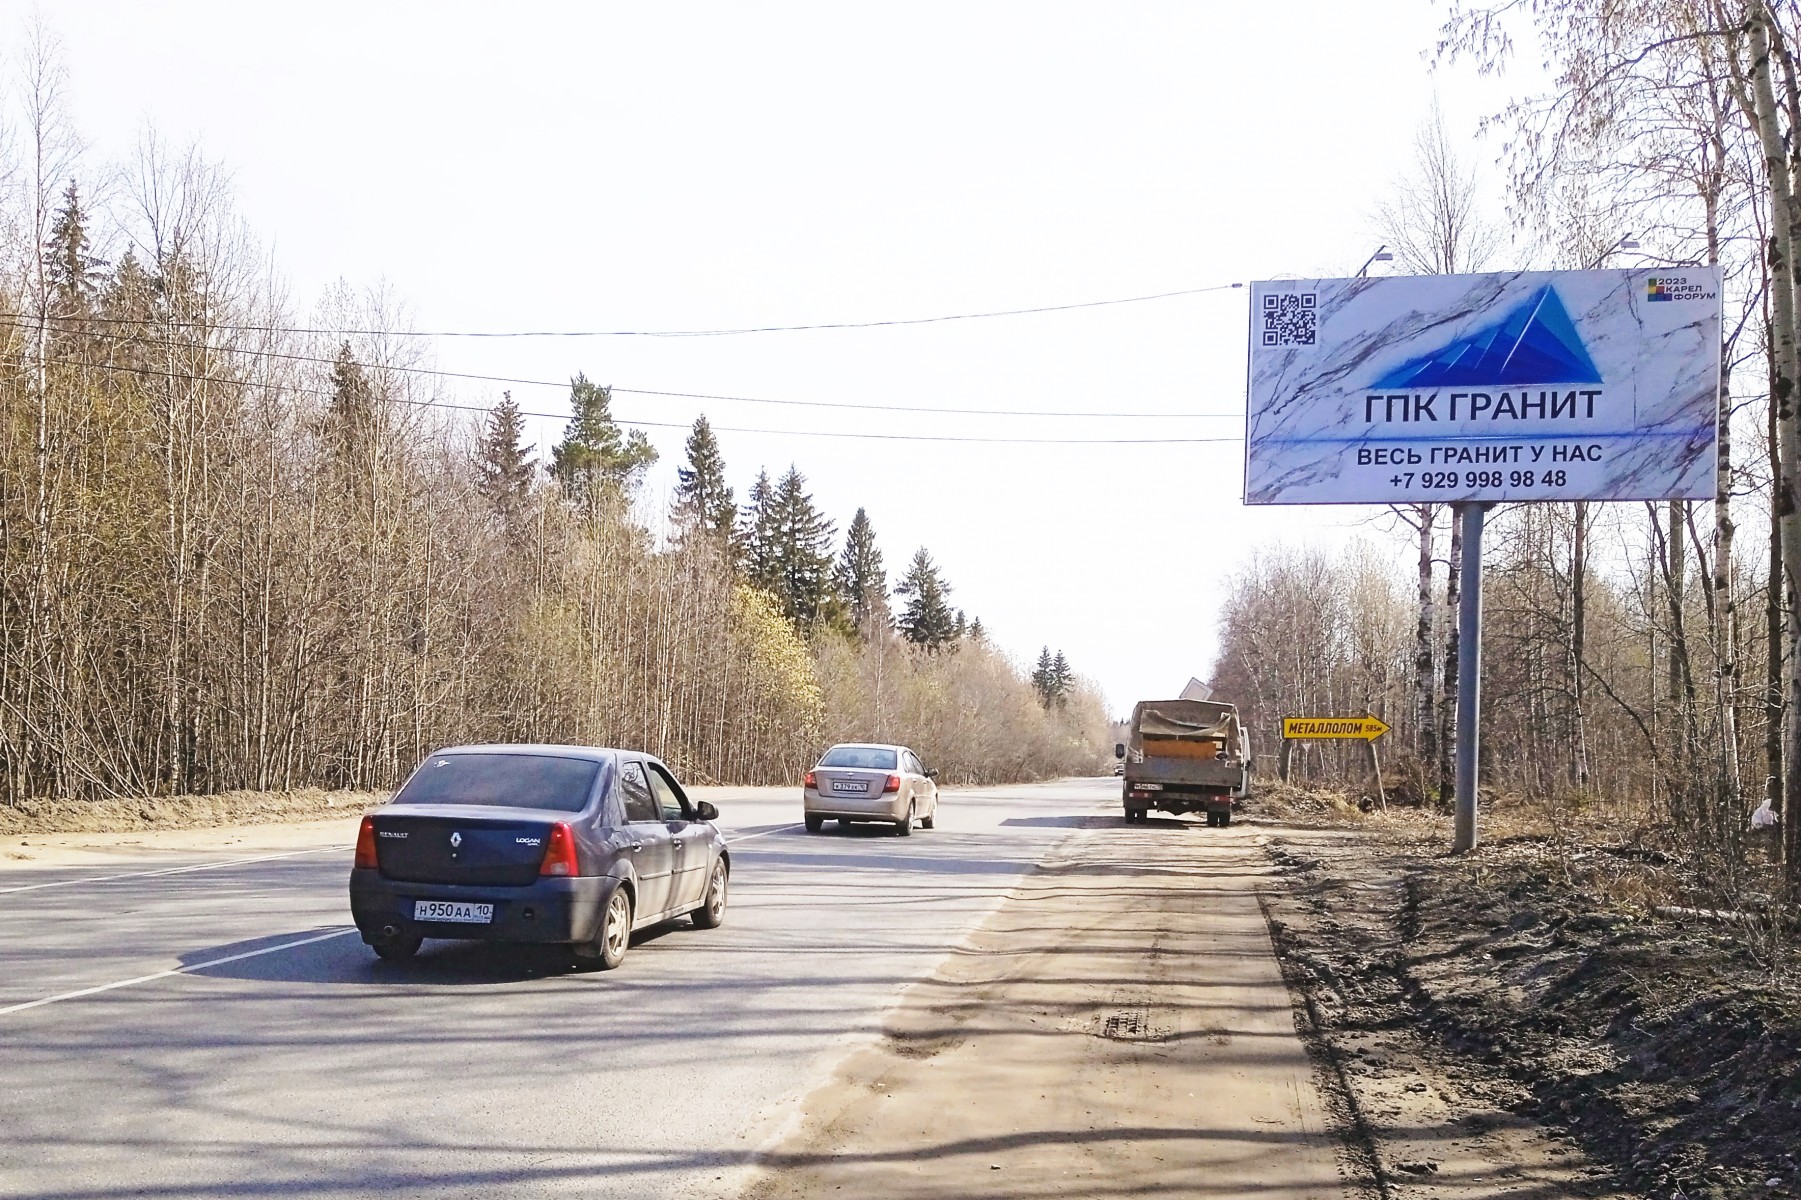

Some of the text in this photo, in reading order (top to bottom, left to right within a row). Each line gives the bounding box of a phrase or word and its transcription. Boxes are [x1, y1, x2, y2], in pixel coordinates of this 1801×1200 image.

[1666, 285, 1702, 293] КАРЕЛ
[1673, 292, 1716, 300] ФОРУМ
[1364, 390, 1603, 423] ГПК ГРАНИТ
[1357, 444, 1603, 466] ВЕСЬ ГРАНИТ У НАС
[1389, 469, 1567, 489] +7 929 998 98 48
[1288, 722, 1363, 734] МЕТАЛЛОЛОМ
[476, 904, 489, 915] 10
